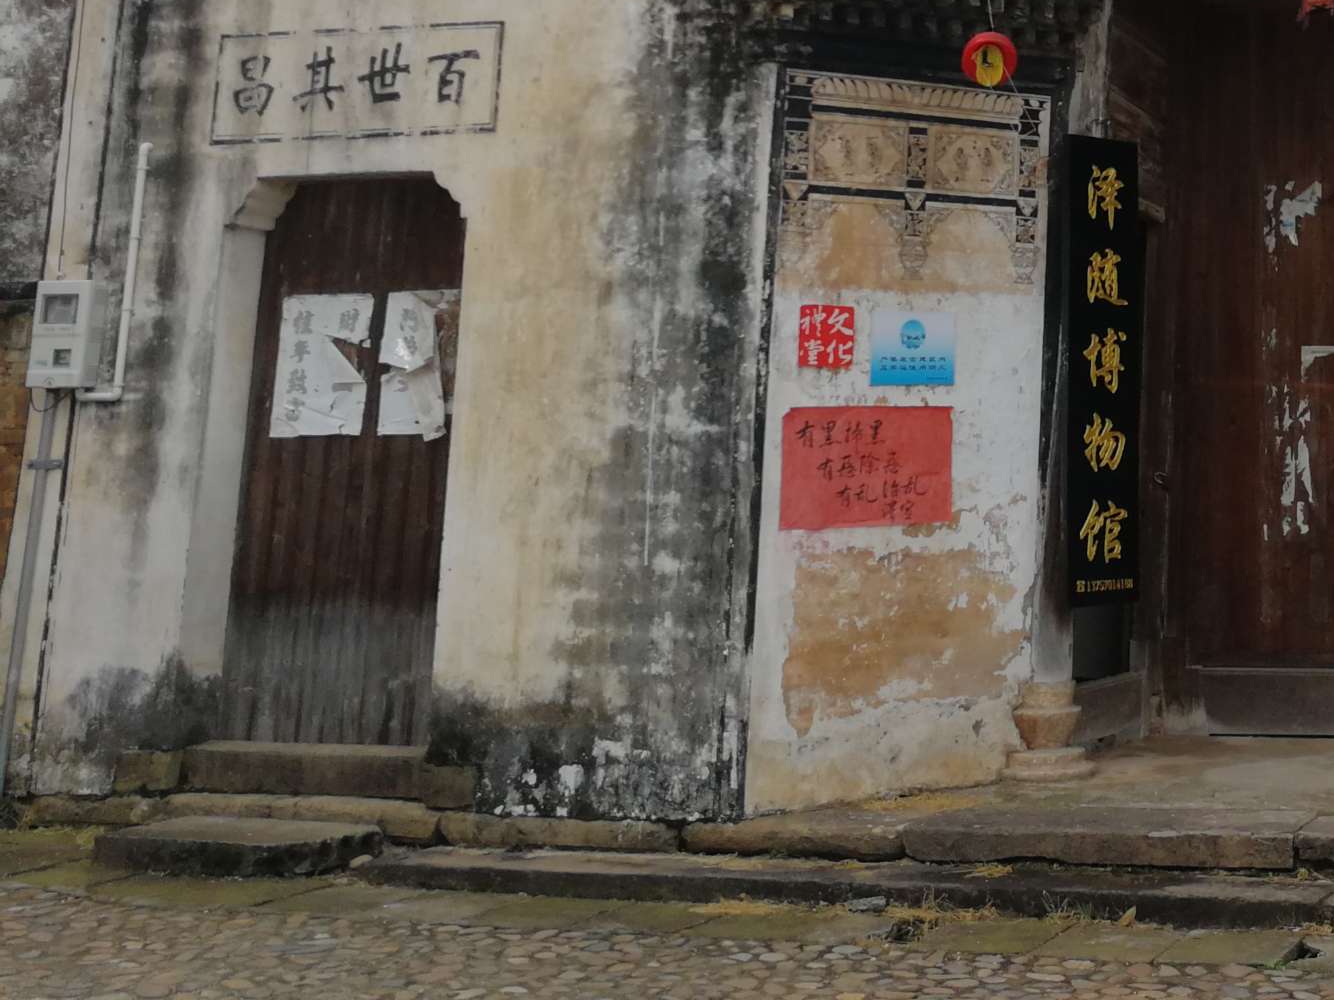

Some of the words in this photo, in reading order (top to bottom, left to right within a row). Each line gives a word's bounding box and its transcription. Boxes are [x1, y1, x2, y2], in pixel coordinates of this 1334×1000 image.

[232, 42, 481, 118] 百世其昌
[1078, 164, 1130, 564] 泽随博物馆
